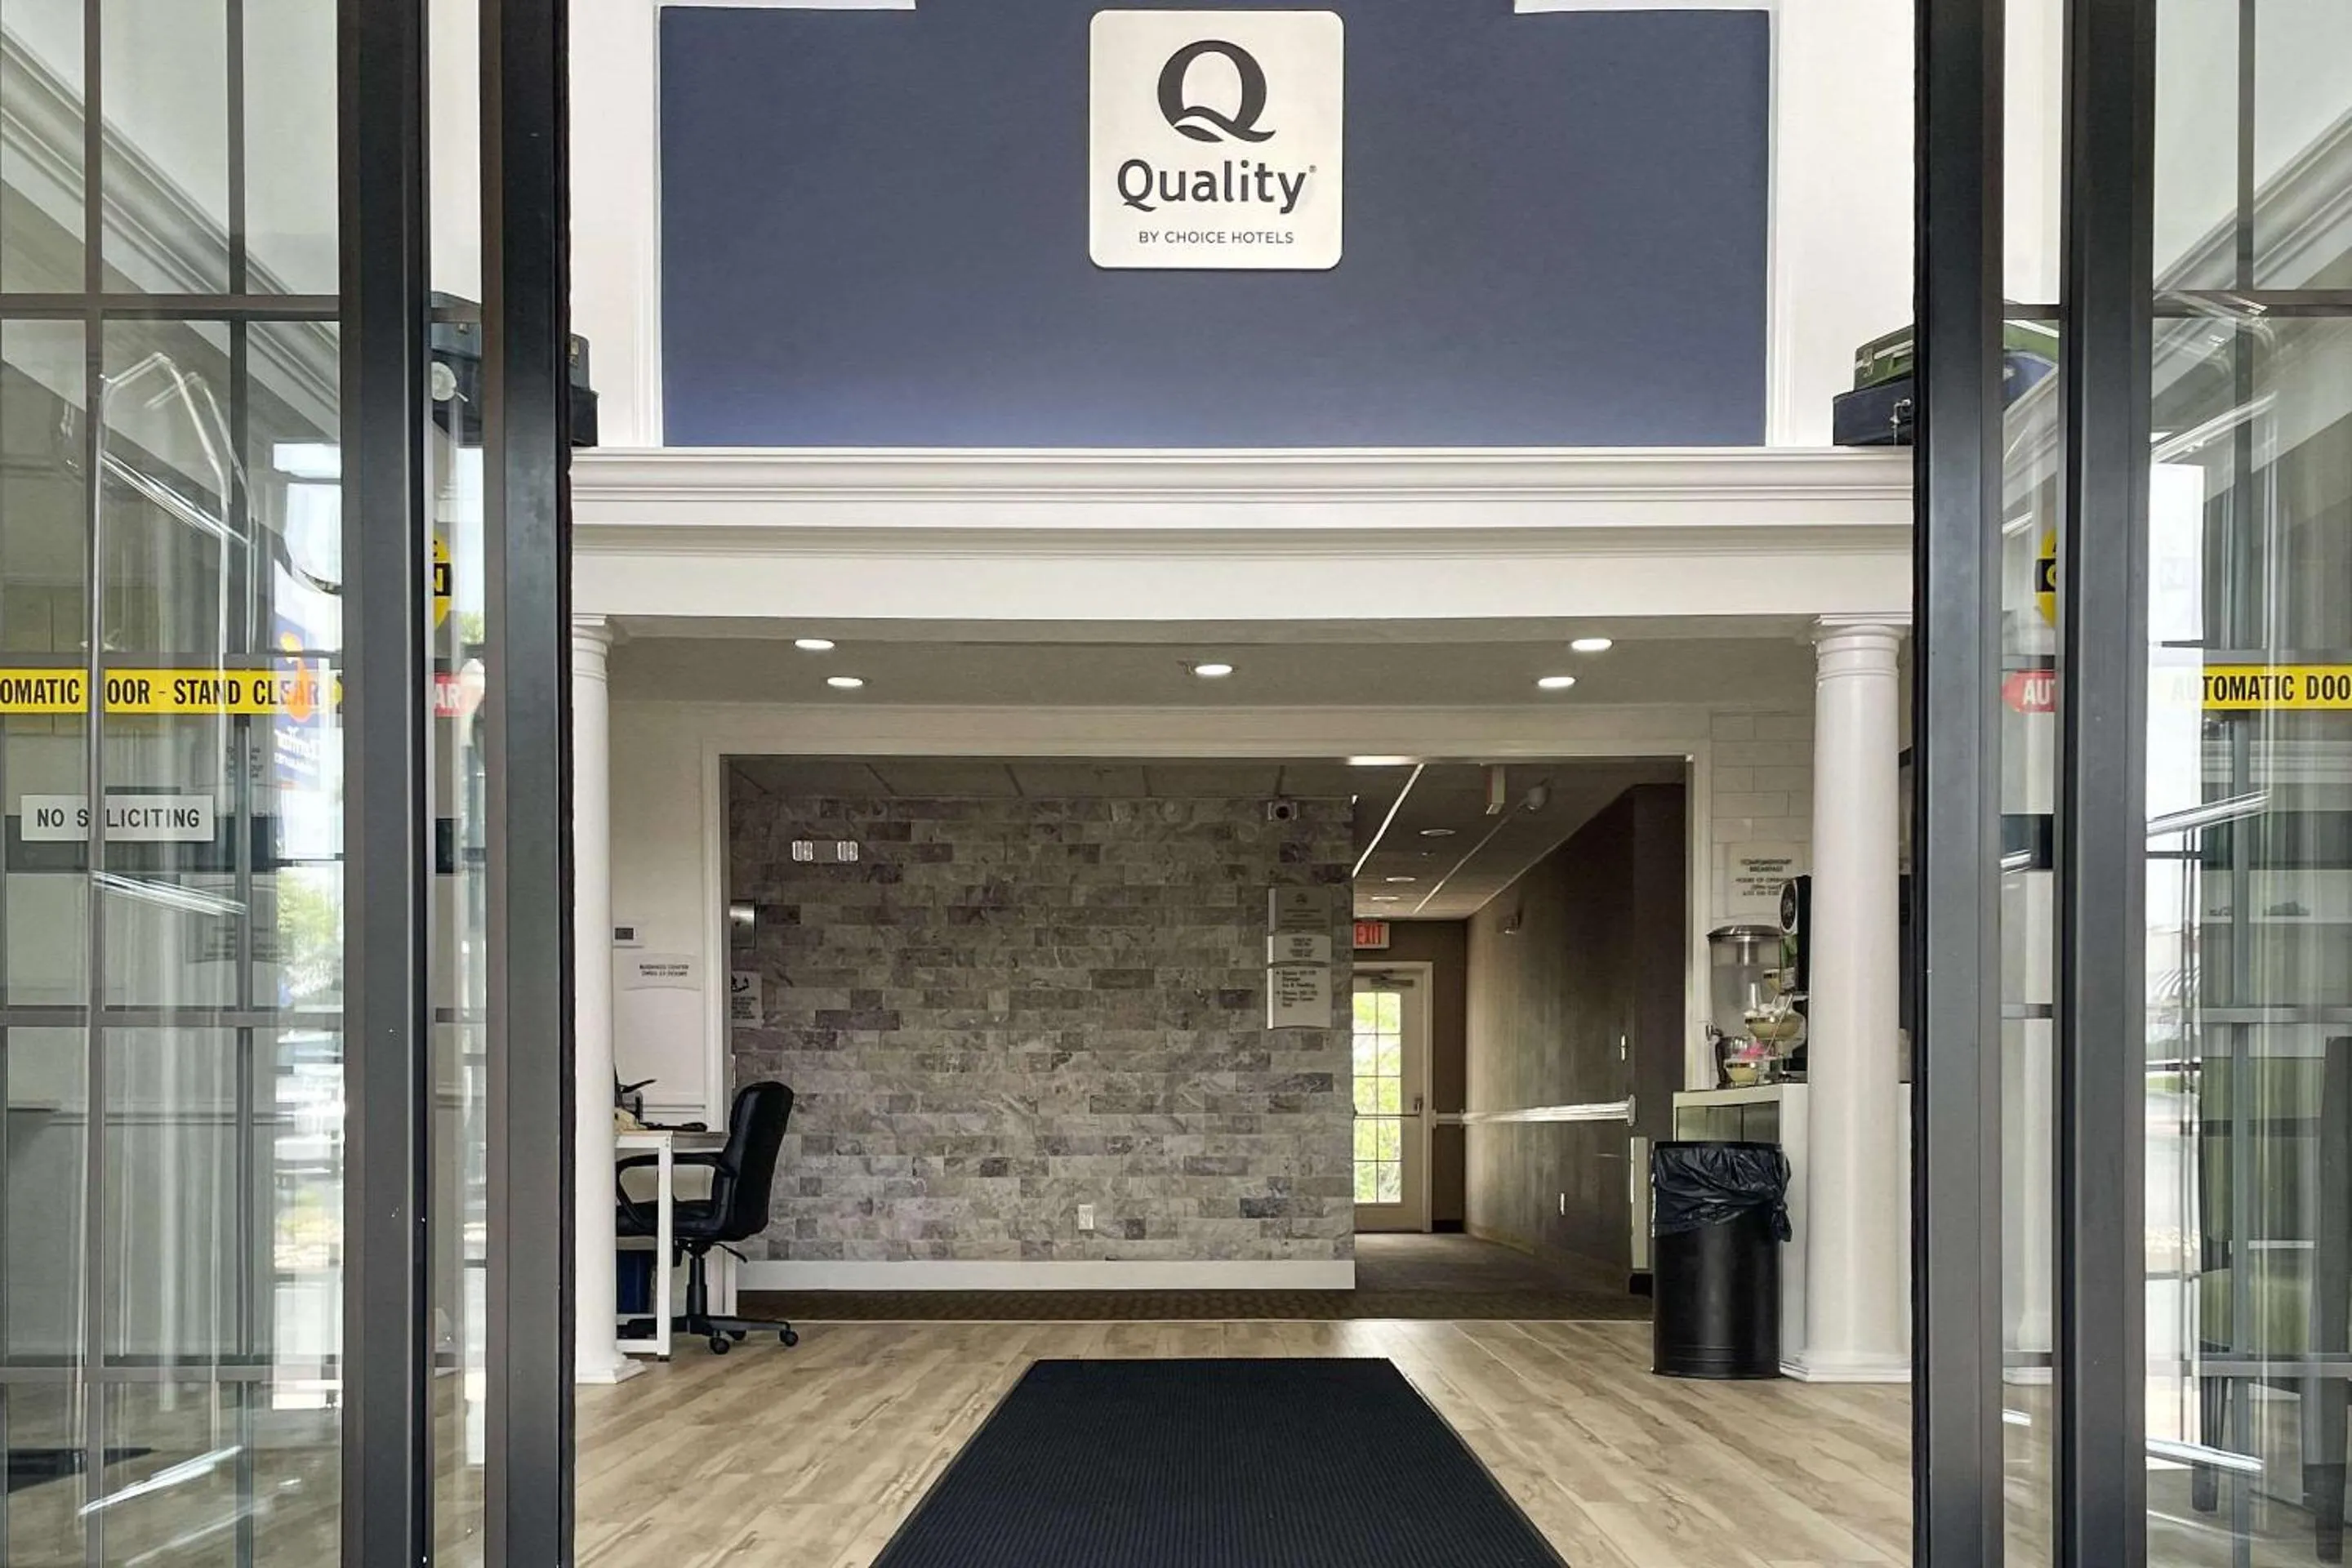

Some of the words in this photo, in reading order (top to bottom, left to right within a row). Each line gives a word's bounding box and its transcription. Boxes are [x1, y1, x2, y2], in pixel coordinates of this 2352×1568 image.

[1157, 39, 1276, 143] Q
[1117, 158, 1307, 214] Quality
[1139, 231, 1160, 243] BY
[1165, 231, 1226, 243] CHOICE
[1232, 231, 1294, 243] HOTELS
[107, 679, 150, 705] OOR
[174, 679, 241, 705] STAND
[253, 679, 319, 705] CLEAR
[37, 808, 65, 827] NO
[77, 808, 200, 827] SLICITING
[1356, 924, 1383, 944] EXIT
